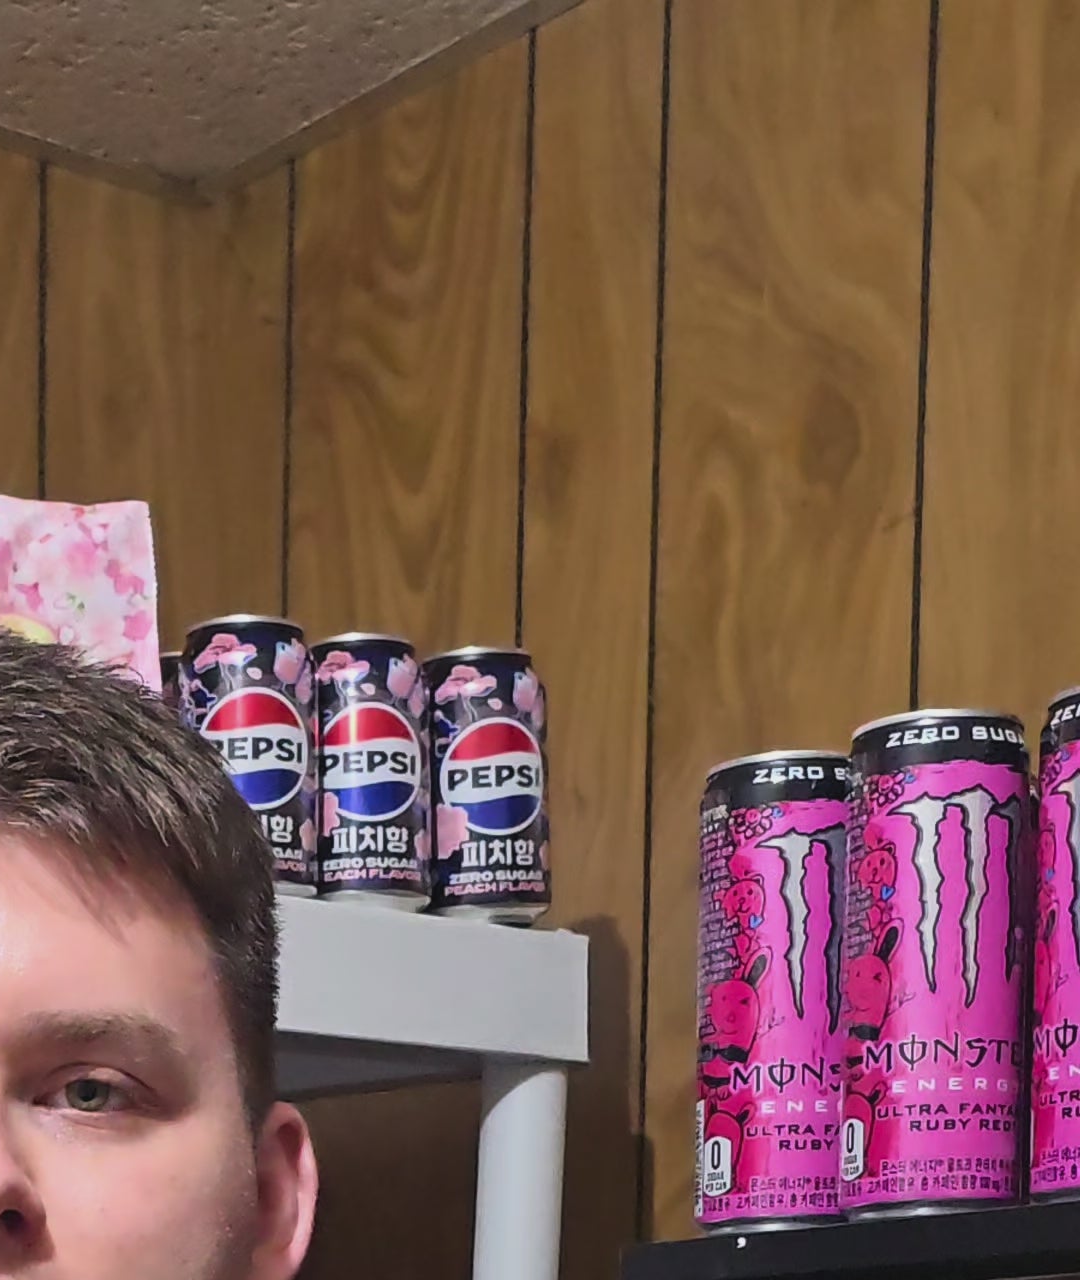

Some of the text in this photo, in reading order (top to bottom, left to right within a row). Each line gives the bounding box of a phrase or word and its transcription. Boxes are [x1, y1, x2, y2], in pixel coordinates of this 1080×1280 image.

[886, 725, 960, 748] ZERO
[323, 750, 416, 778] PEPSI
[447, 764, 540, 791] PEPSI
[752, 766, 825, 785] ZERO
[331, 825, 409, 854] 피치향
[460, 839, 535, 868] 피치향
[324, 870, 367, 882] EACH
[449, 870, 494, 885] ZERO
[444, 882, 497, 896] PEACH
[877, 1103, 949, 1119] ULTRA
[746, 1123, 816, 1137] ULTRA
[909, 1118, 972, 1132] RUBY
[778, 1139, 834, 1151] RUBY
[711, 1140, 721, 1170] 0
